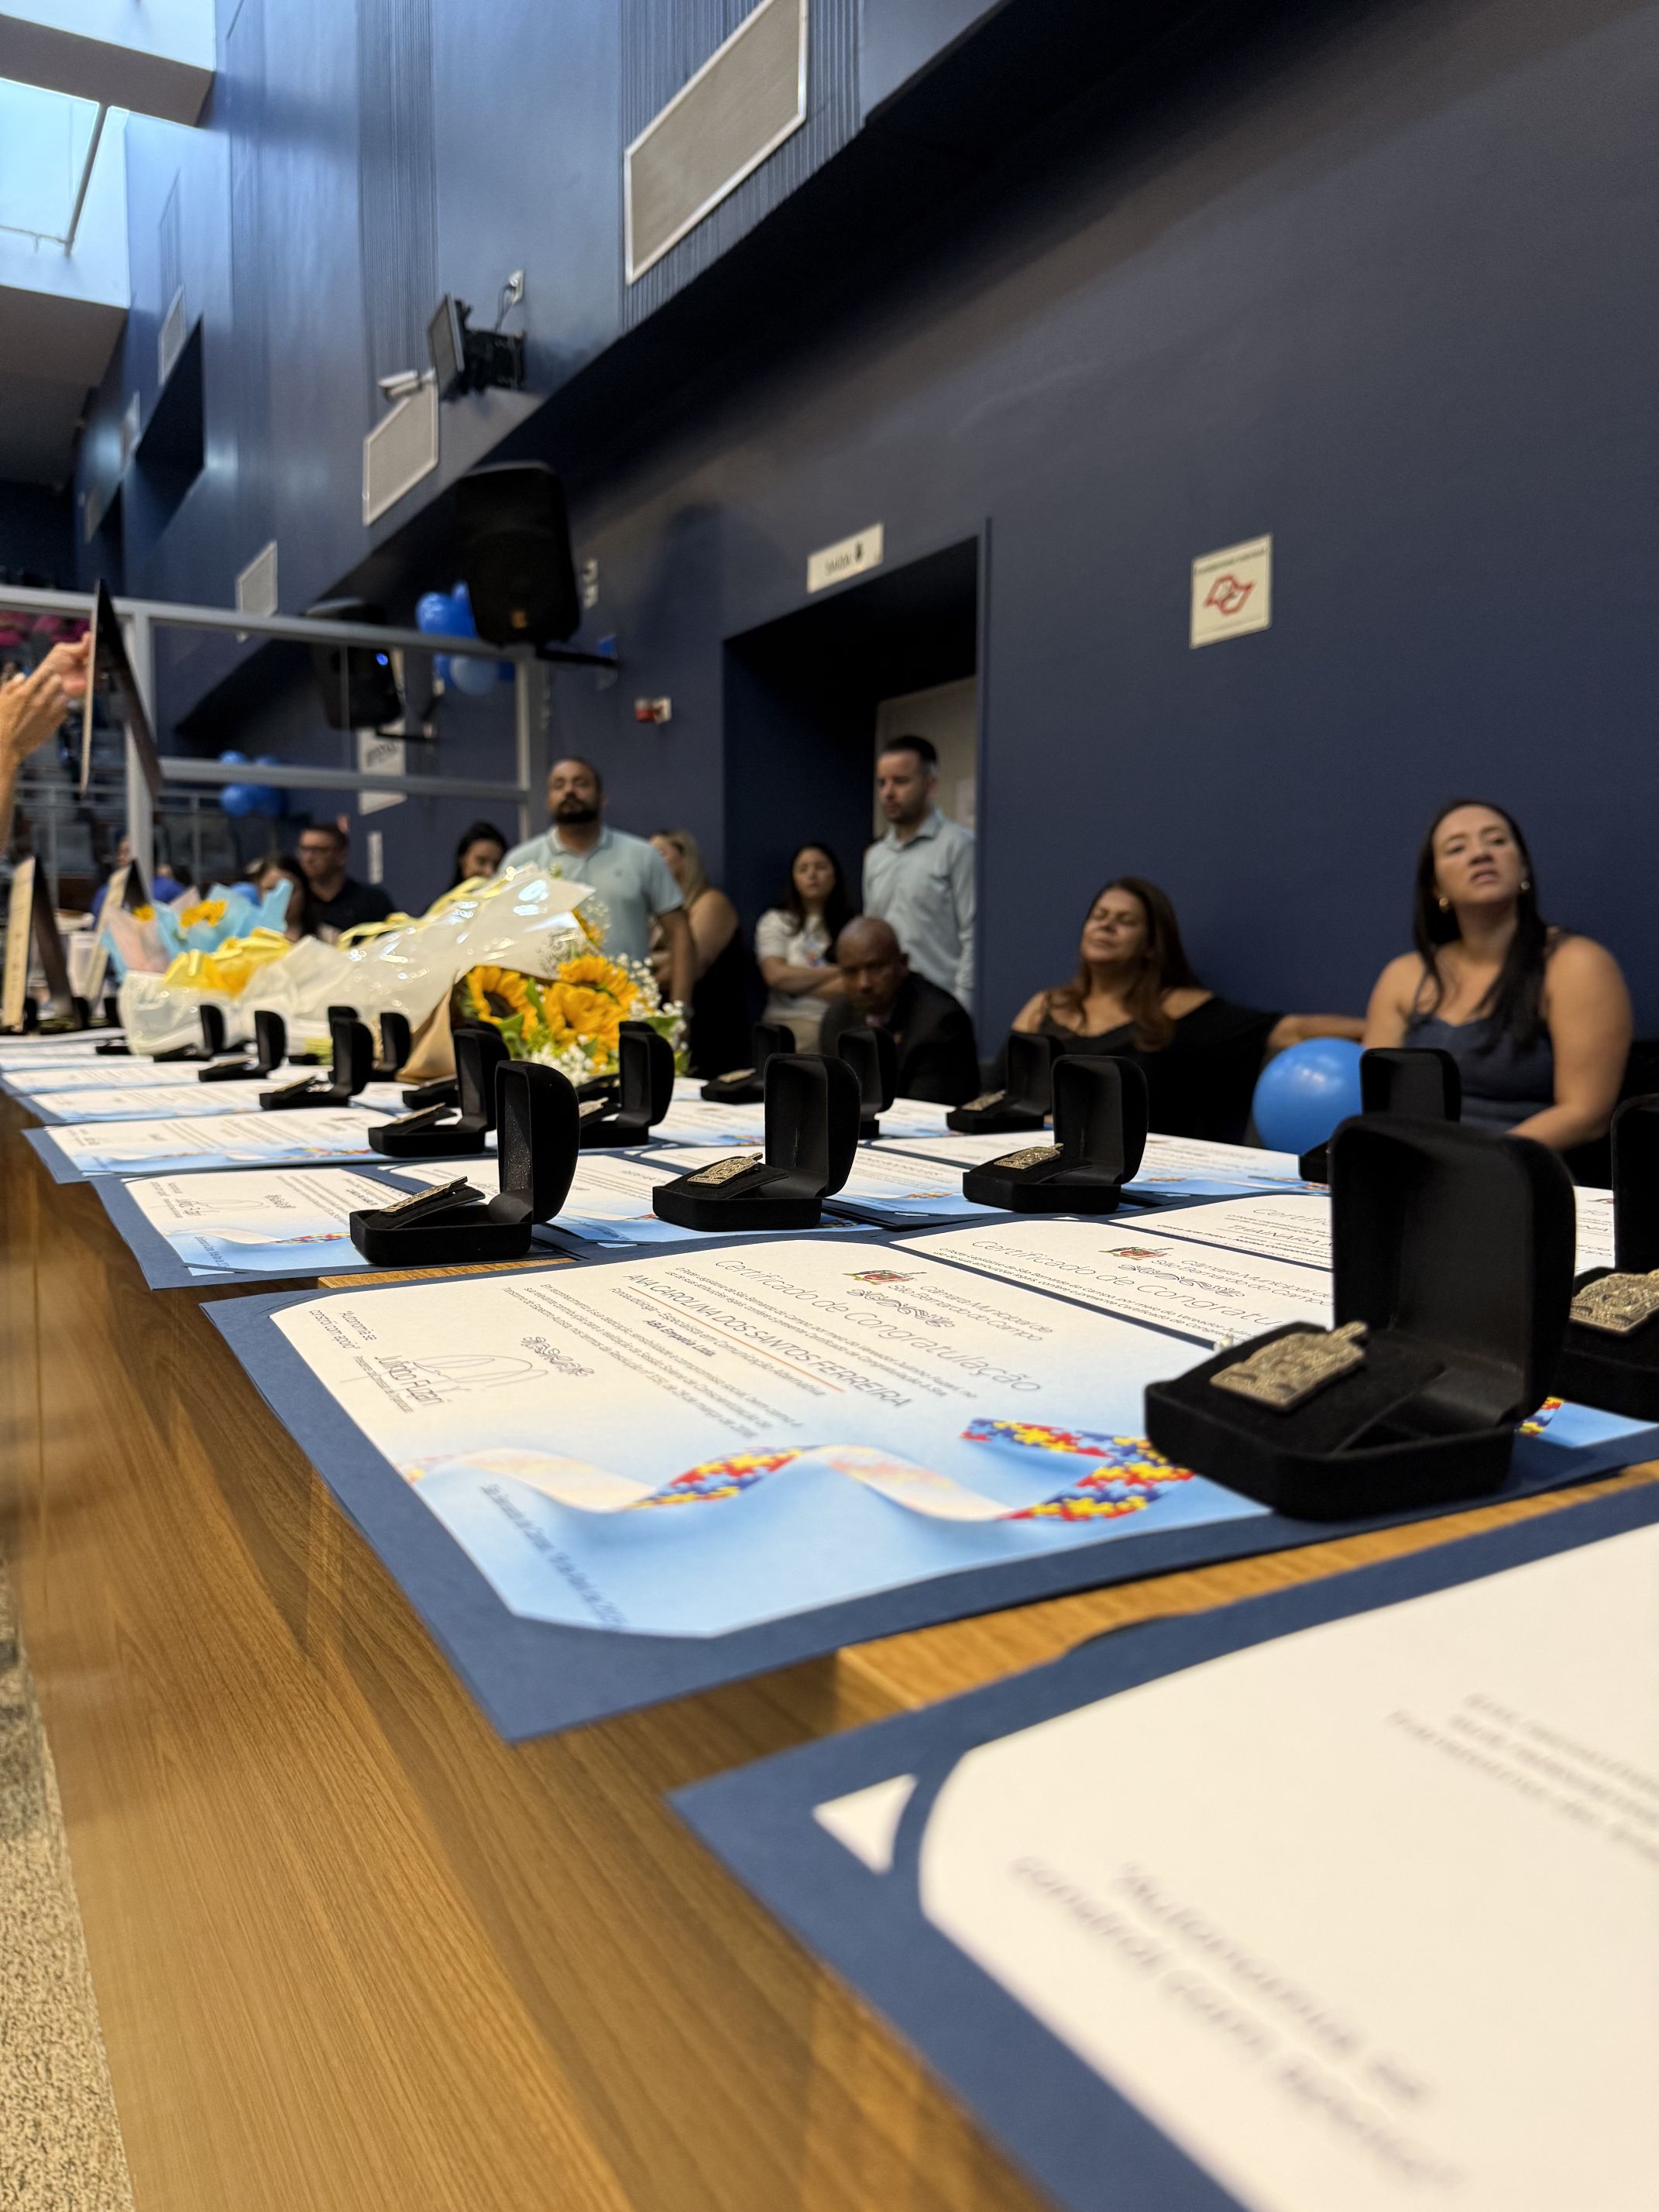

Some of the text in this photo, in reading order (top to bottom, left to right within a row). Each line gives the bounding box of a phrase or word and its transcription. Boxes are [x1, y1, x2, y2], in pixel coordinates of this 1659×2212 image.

[1228, 1224, 1320, 1245] THAINARA
[1252, 1208, 1333, 1225] Certific
[972, 1240, 1283, 1325] Certificado de Congratu
[1150, 1259, 1180, 1268] São
[1178, 1266, 1248, 1285] Bernardo
[1271, 1289, 1334, 1307] Campo
[1180, 1259, 1238, 1276] Câmara
[1238, 1273, 1316, 1293] Municipal
[715, 1260, 1042, 1391] Certificado de Congratulação
[887, 1284, 1042, 1341] São Bernardo do Campo
[919, 1285, 1053, 1333] Câmara Municipal de
[623, 1274, 912, 1407] ANA CAROLINA DOS SANTOS FERREIRA
[642, 1319, 716, 1357] ABA Empatia Ltda.
[375, 1355, 444, 1403] Julinho Fuzari
